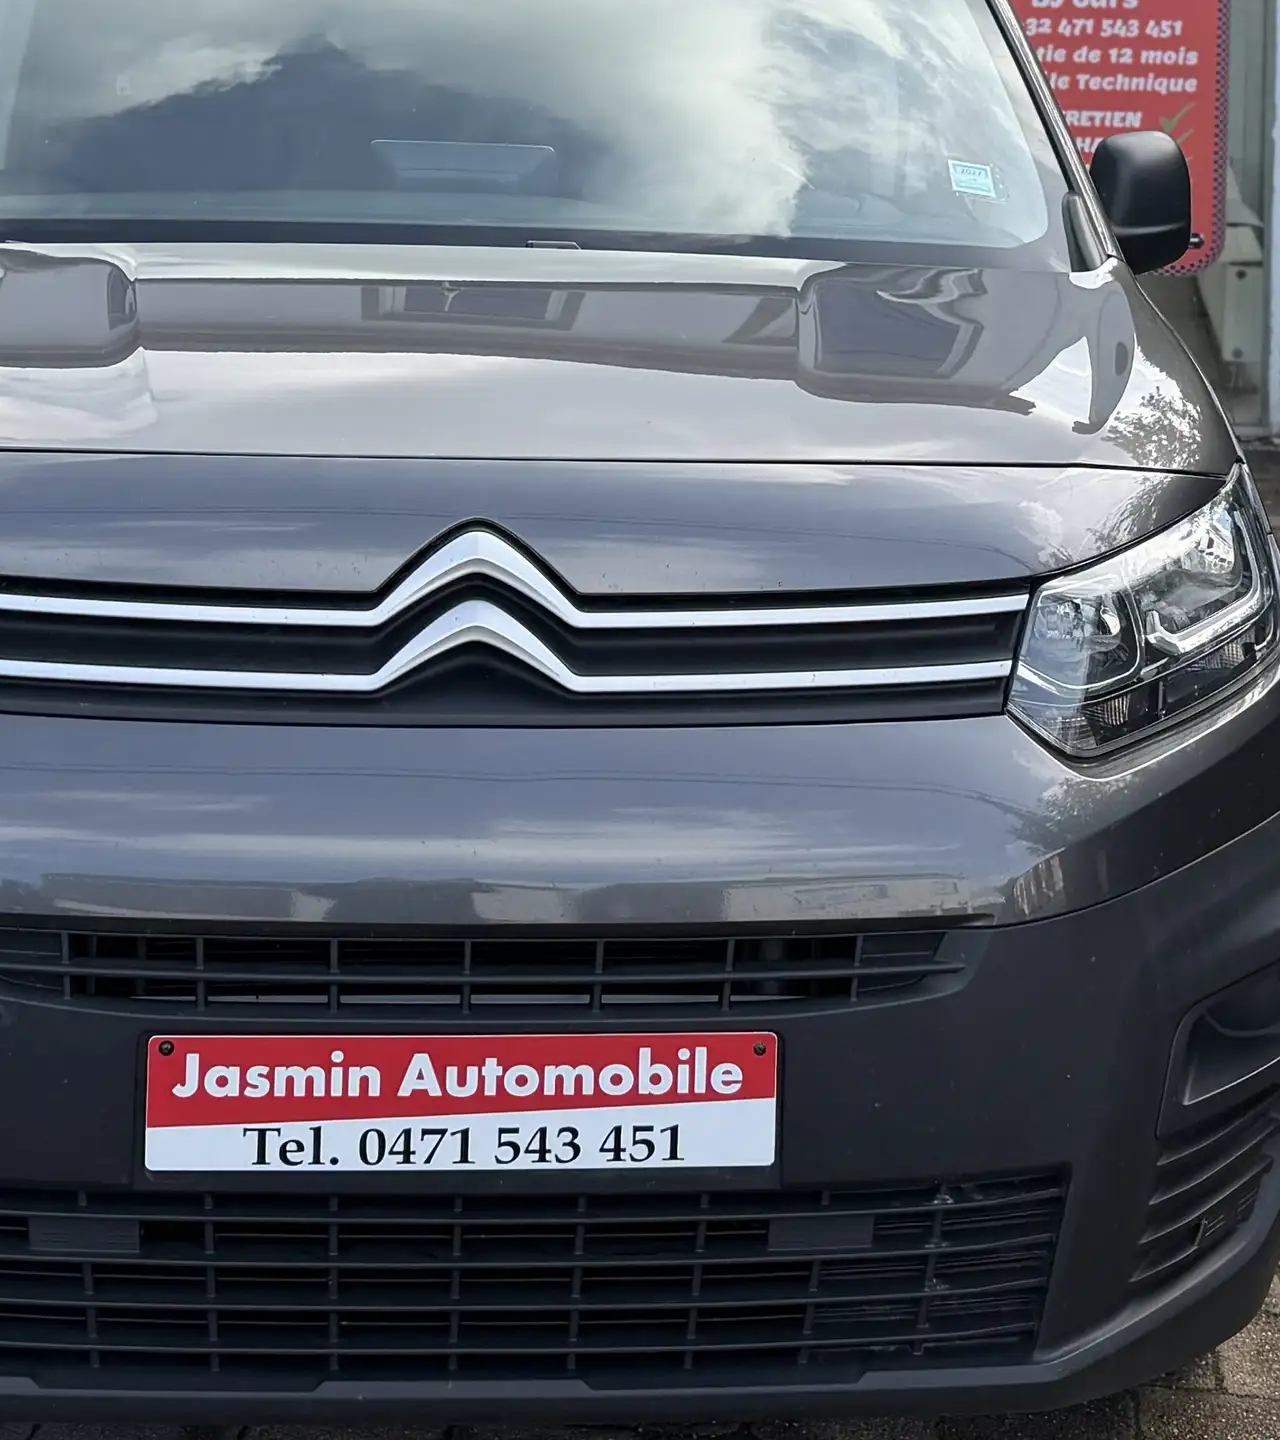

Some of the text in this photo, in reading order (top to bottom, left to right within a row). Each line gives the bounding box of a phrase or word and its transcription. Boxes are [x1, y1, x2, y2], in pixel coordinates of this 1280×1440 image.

[1025, 17, 1183, 39] 32 471 543 451
[1035, 44, 1199, 66] tie de 12 mois
[1076, 72, 1198, 95] Technique
[1065, 110, 1143, 128] RETIEN
[171, 1047, 744, 1099] Jasmin Automobile
[242, 1123, 686, 1167] Tel. 0471 543 451
